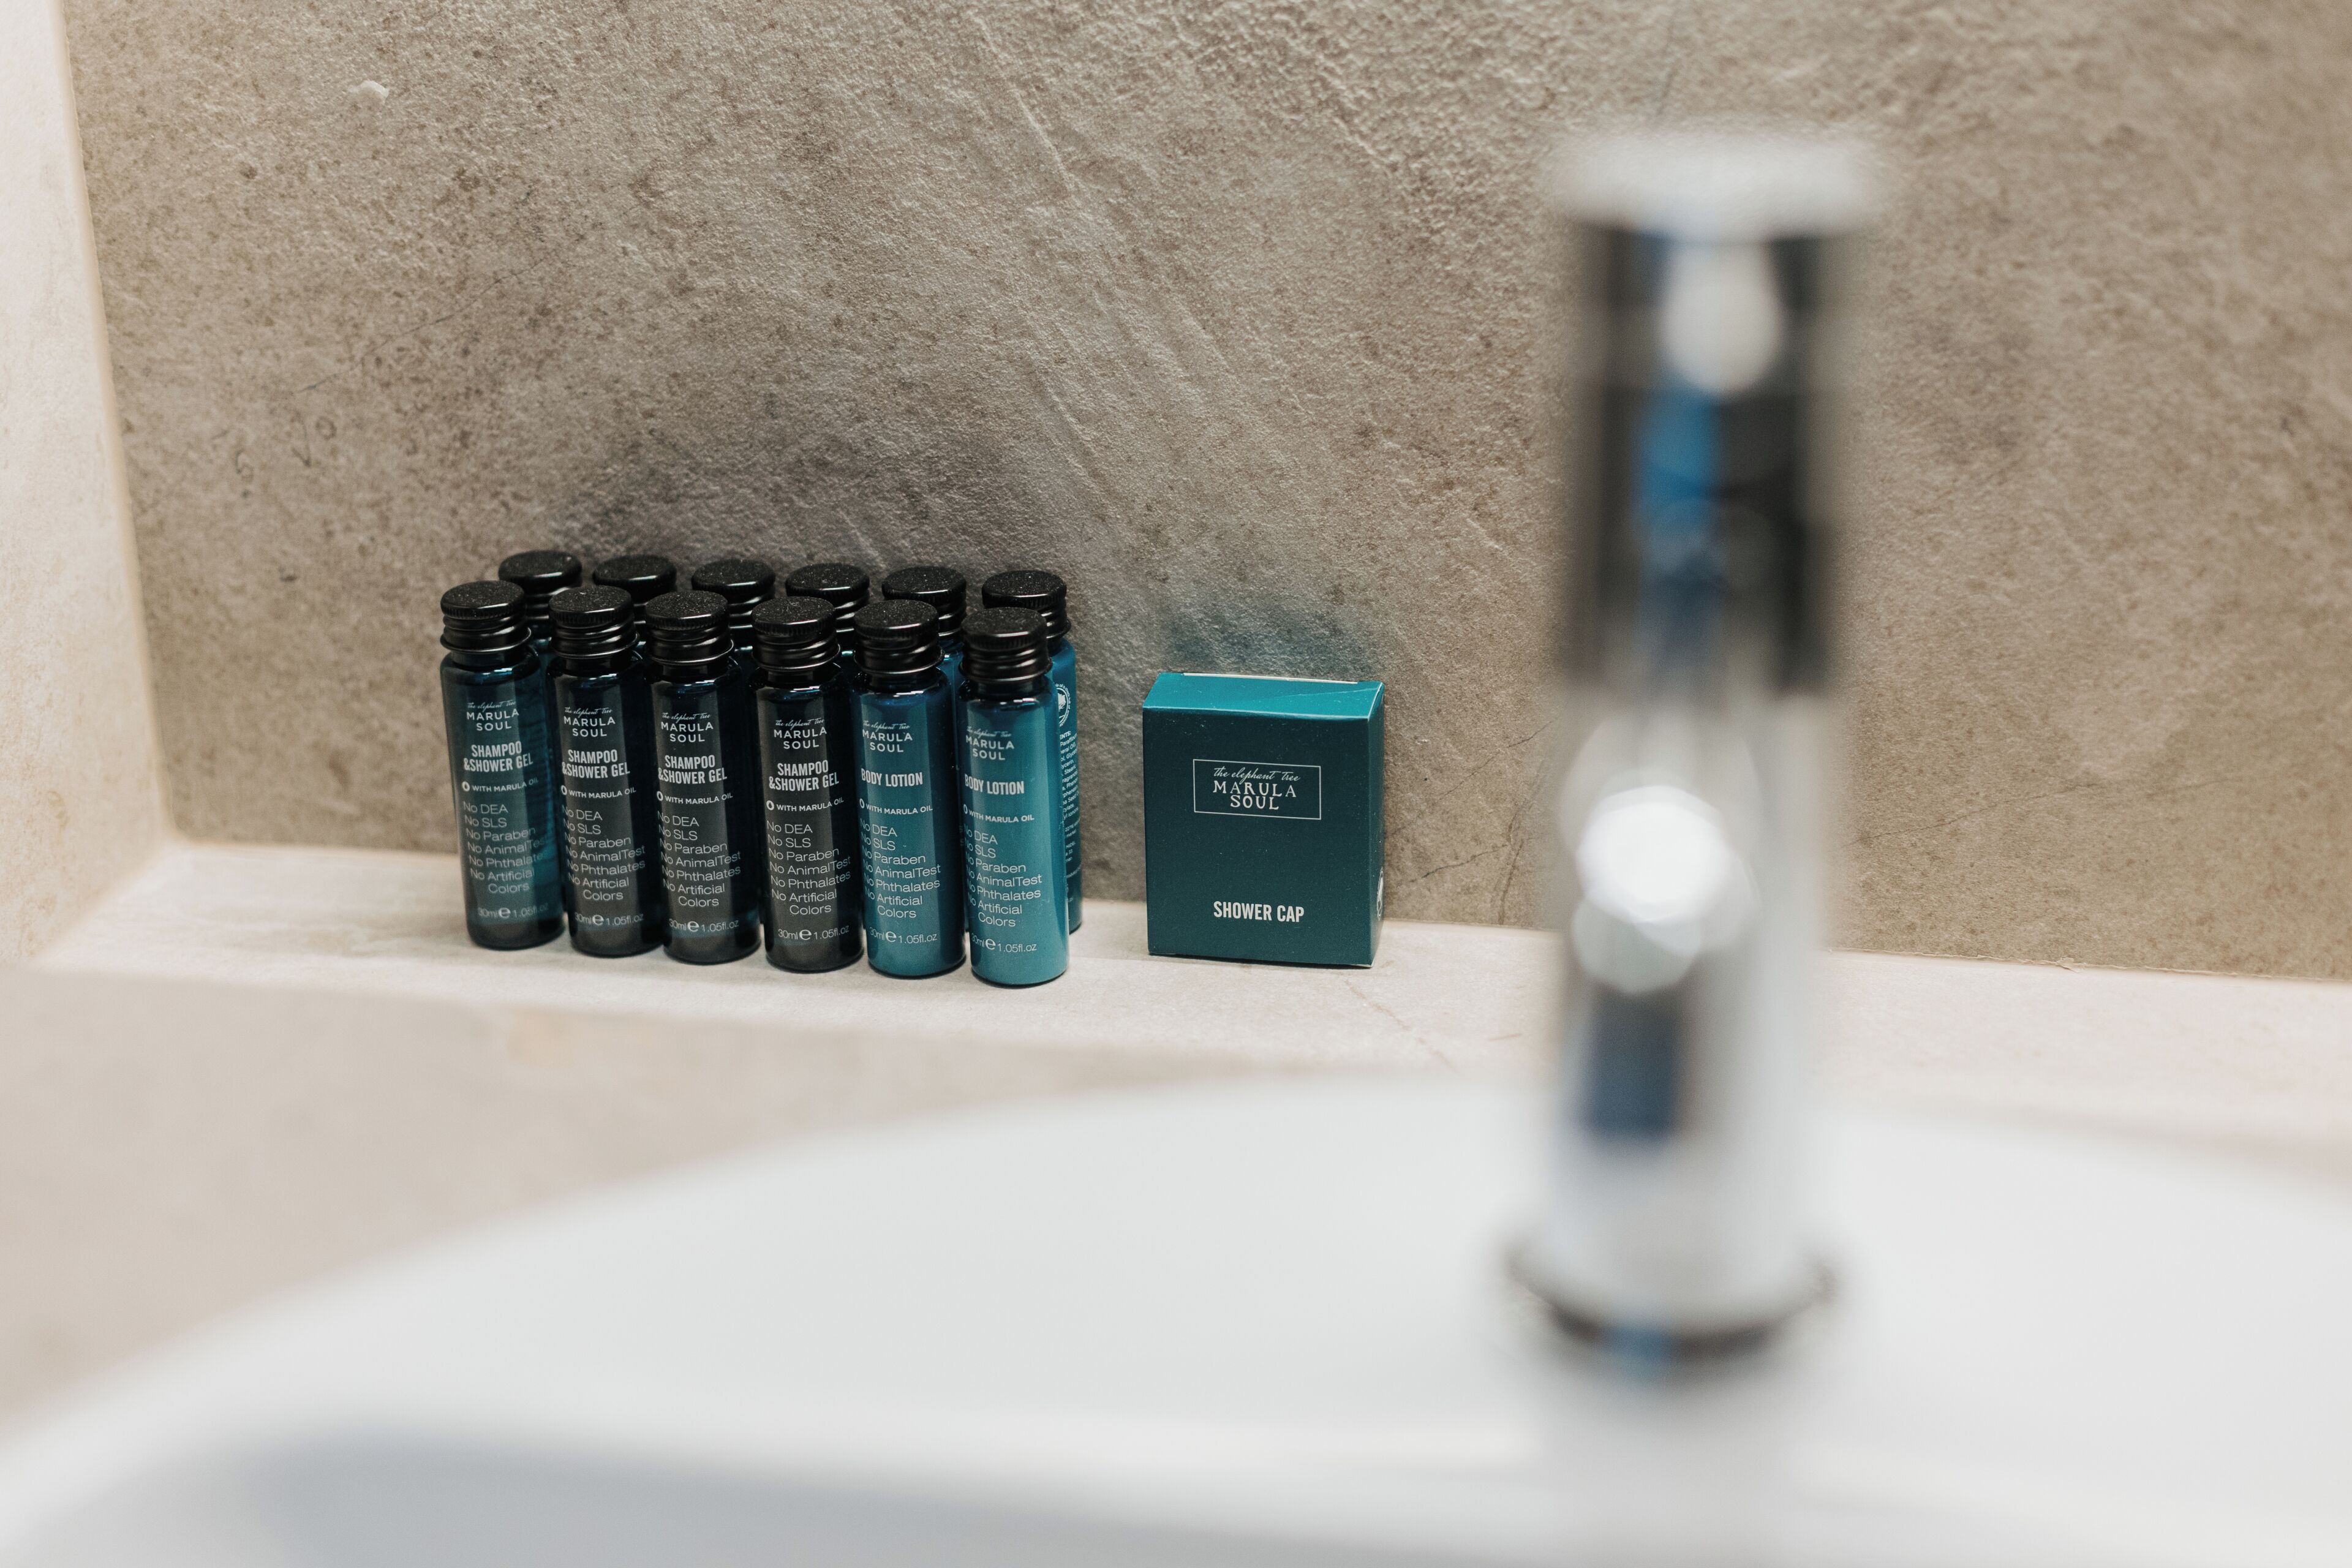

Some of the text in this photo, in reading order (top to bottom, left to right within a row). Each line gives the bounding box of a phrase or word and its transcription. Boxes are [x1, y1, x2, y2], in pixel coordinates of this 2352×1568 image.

[467, 708, 519, 720] MARULA
[564, 715, 616, 726] MARULA
[476, 721, 512, 731] SOUL
[572, 728, 607, 737] SOUL
[661, 722, 714, 732] MARULA
[774, 726, 827, 739] MARULA
[669, 734, 705, 742] SOUL
[862, 729, 913, 742] MARULA
[965, 735, 1015, 750] MARULA
[471, 741, 522, 758] SHAMPOO
[783, 739, 820, 750] SOUL
[870, 742, 903, 752] SOUL
[568, 749, 618, 764] SHAMPOO
[973, 748, 1006, 760] SOUL
[463, 753, 533, 772] &SHOWER GEL
[665, 755, 715, 769] SHAMPOO
[777, 760, 829, 777] SHAMPOO
[562, 761, 630, 778] &SHOWER GEL
[658, 767, 728, 785] &SHOWER GEL
[1213, 766, 1231, 777] the
[769, 772, 840, 791] &SHOWER GEL
[861, 767, 923, 787] BODY LOTION
[494, 782, 527, 792] MARULA
[965, 774, 1025, 795] BODY LOTION
[1213, 780, 1297, 797] MARULA
[569, 786, 636, 799] WITH MARULA OIL
[665, 796, 683, 804] WITH
[799, 801, 832, 812] MARULA
[834, 797, 845, 805] OIL
[1231, 794, 1280, 810] SOUL
[464, 801, 508, 814] No DEA
[562, 804, 603, 821] No DEA
[865, 803, 882, 813] WITH
[466, 814, 507, 827] No SLS
[658, 810, 699, 827] No DEA
[968, 809, 984, 820] WITH
[986, 815, 1019, 823] MARULA
[564, 818, 601, 835] No SLS
[659, 824, 698, 840] No SLS
[767, 820, 813, 834] No DEA
[872, 824, 897, 837] DEA
[466, 827, 535, 842] No Paraben
[565, 832, 631, 848] No Paraben
[768, 834, 811, 848] No SLS
[974, 830, 998, 845] DEA
[468, 842, 482, 853] No
[566, 845, 578, 858] No
[660, 837, 728, 854] No Paraben
[873, 839, 895, 851] SLS
[975, 844, 996, 858] SLS
[469, 854, 484, 867] No
[661, 851, 673, 864] No
[769, 848, 840, 862] No Paraben
[874, 852, 925, 865] Paraben
[567, 859, 646, 875] No Phthalates
[770, 861, 785, 873] No
[976, 858, 1026, 873] Paraben
[470, 867, 535, 881] No Artificial
[662, 865, 741, 881] No Phthalates
[771, 871, 851, 889] No Phthalates
[568, 872, 629, 889] No Artificial
[663, 878, 725, 894] No Artificial
[876, 879, 940, 892] Phthalates
[488, 883, 530, 893] Colors
[583, 889, 624, 901] Colors
[977, 886, 1041, 901] Phthalates
[678, 895, 719, 907] Colors
[772, 889, 837, 903] No Artificial
[876, 894, 922, 906] Artificial
[790, 905, 832, 915] Colors
[877, 905, 916, 918] Colors
[978, 900, 1022, 914] Artificial
[1213, 900, 1305, 922] SHOWER CAP
[978, 912, 1016, 927] Colors
